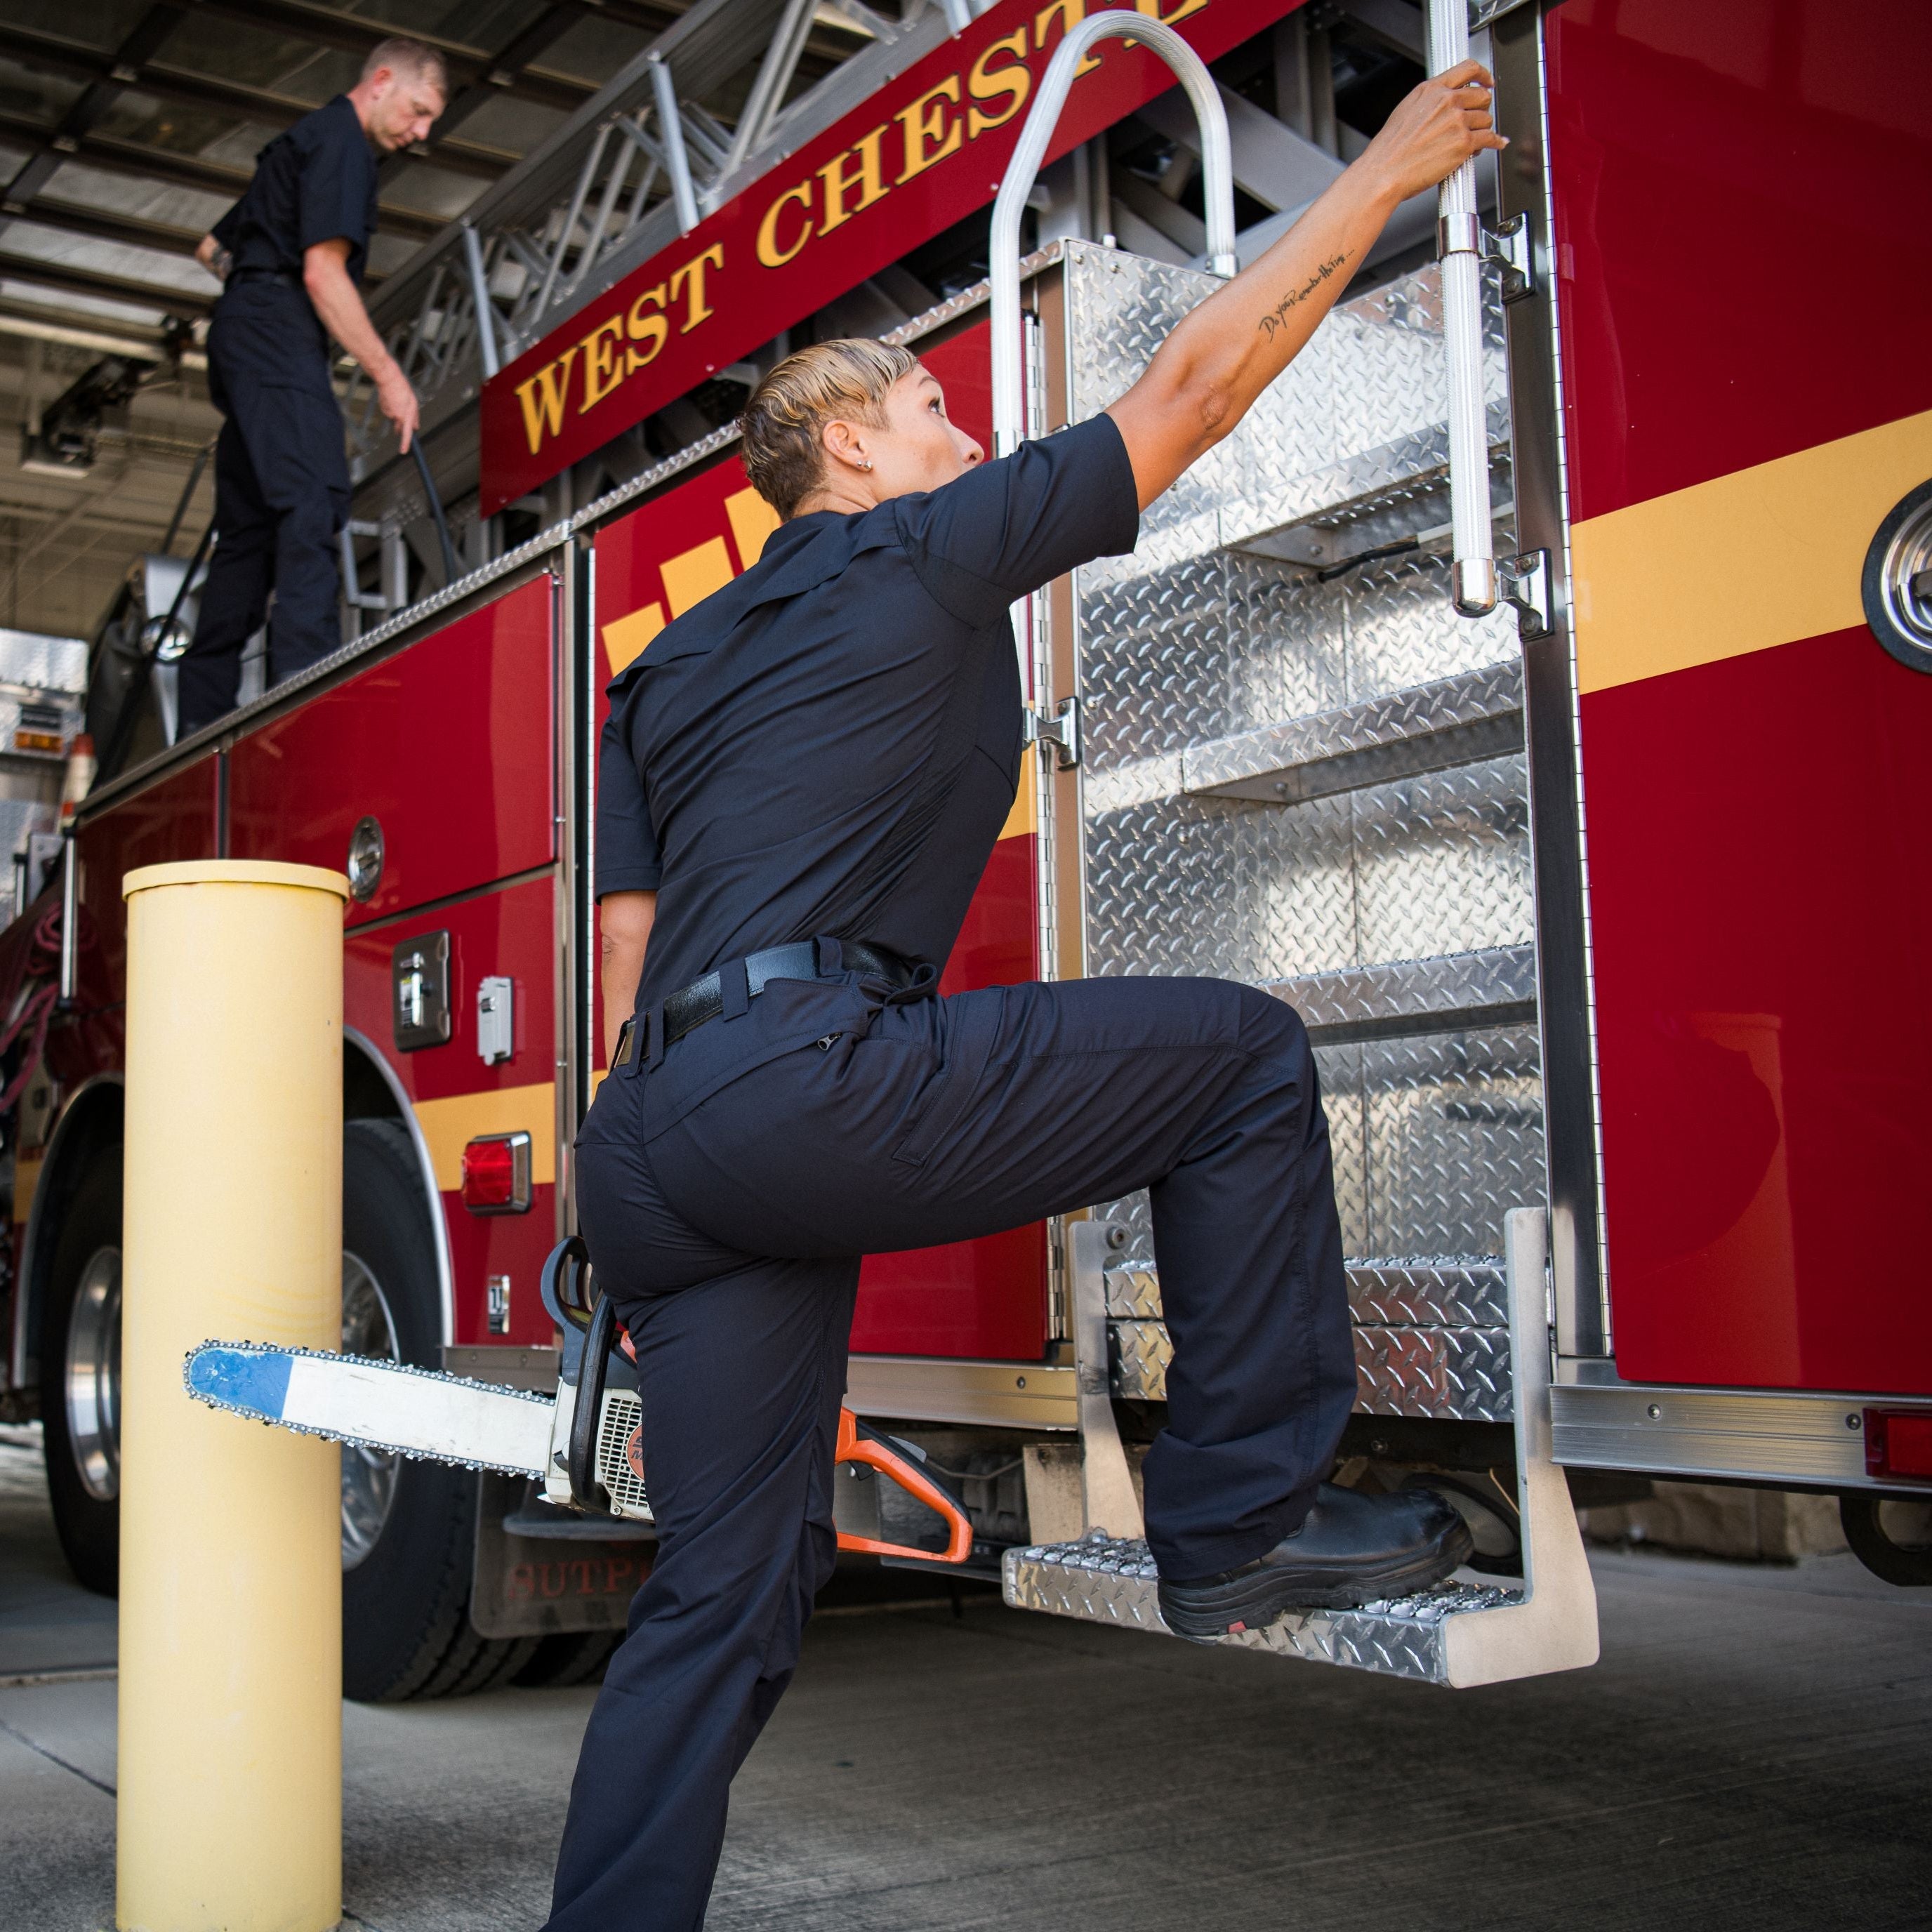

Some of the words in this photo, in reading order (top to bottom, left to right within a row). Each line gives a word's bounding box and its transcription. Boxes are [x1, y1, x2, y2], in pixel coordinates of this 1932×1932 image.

[514, 242, 724, 455] WEST
[1258, 316, 1279, 343] Do
[508, 1557, 652, 1601] SUTP
